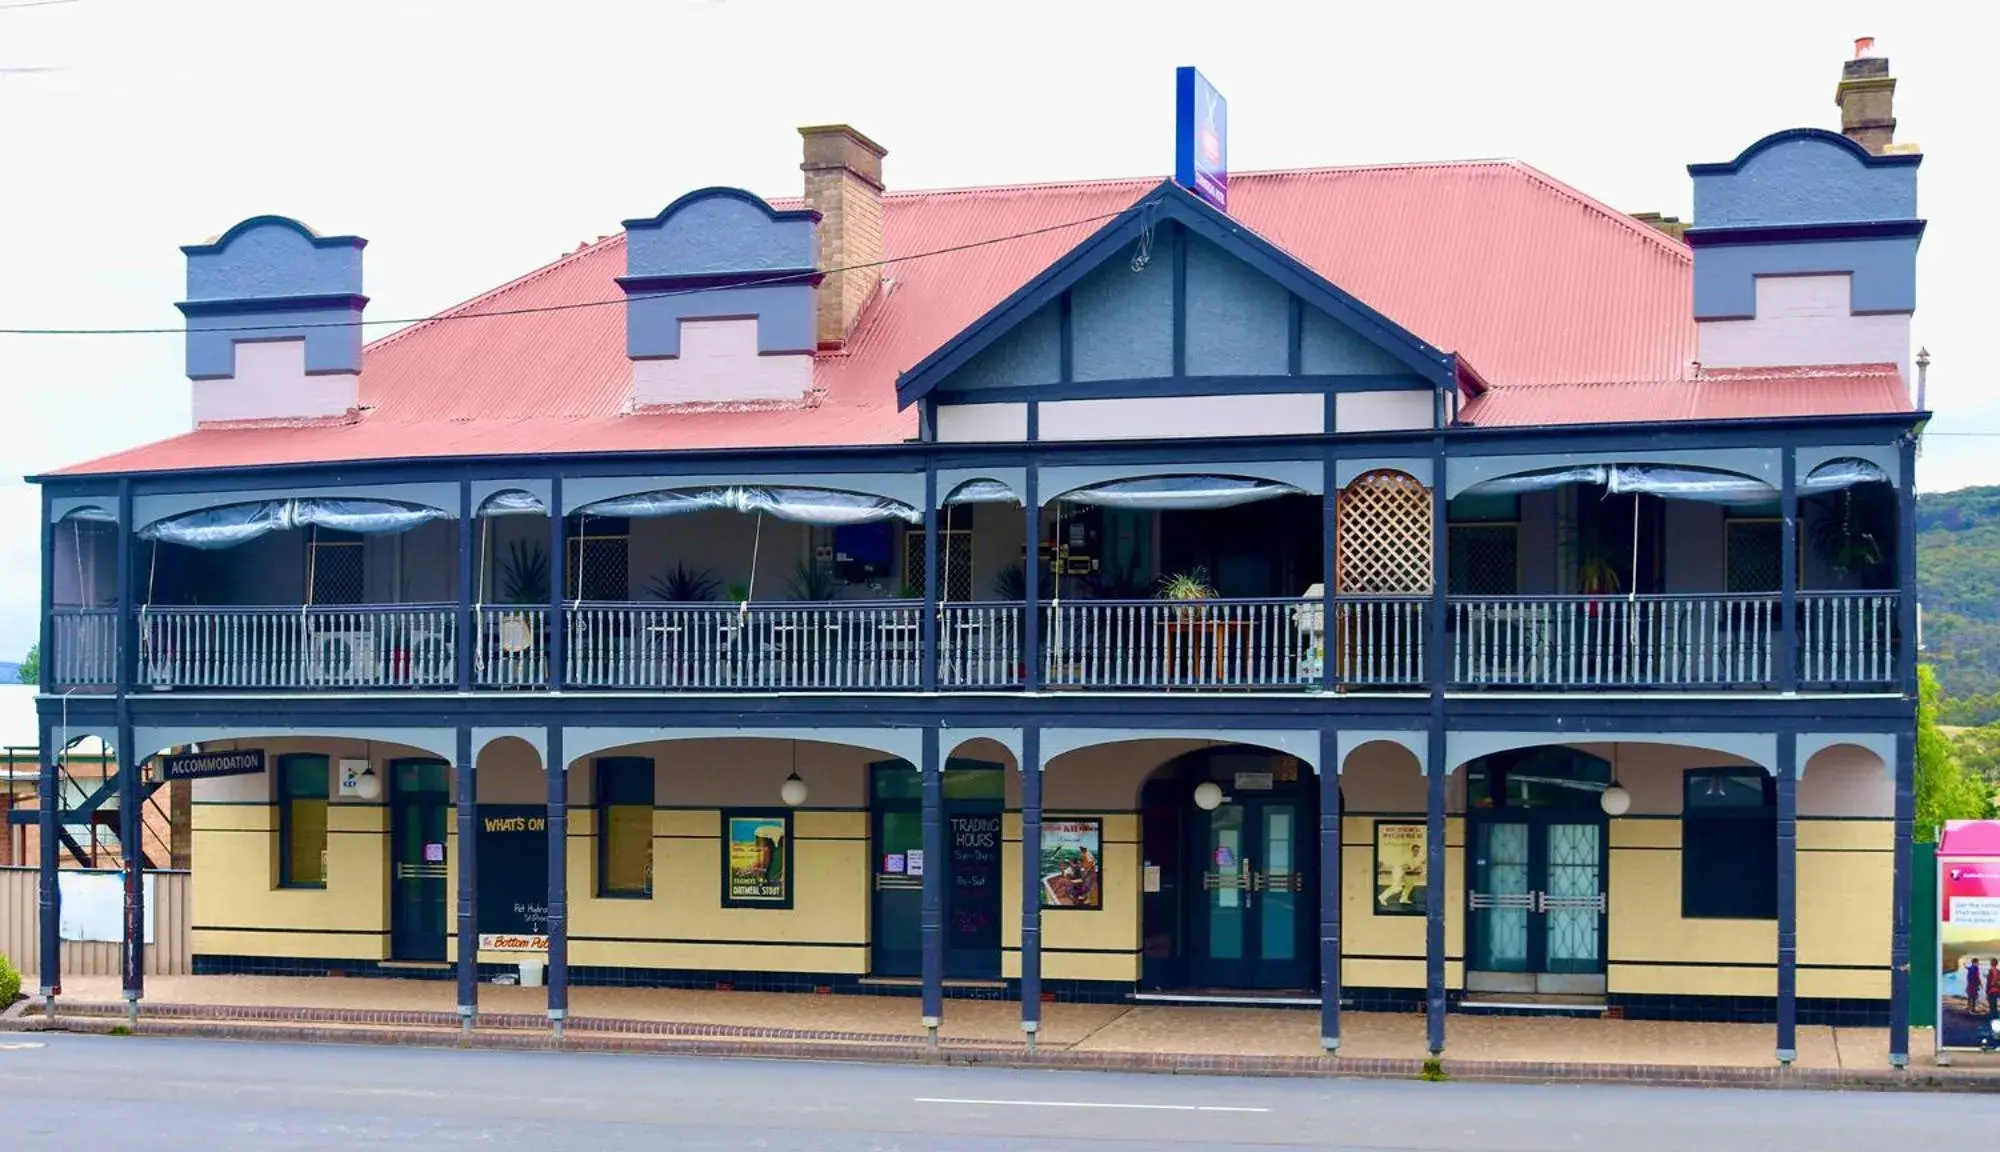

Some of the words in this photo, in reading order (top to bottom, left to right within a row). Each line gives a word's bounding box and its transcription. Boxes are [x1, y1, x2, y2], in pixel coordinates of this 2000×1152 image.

[171, 755, 258, 774] ACCOMMODATION
[528, 818, 545, 831] ON
[951, 818, 999, 832] TRADING
[956, 833, 994, 847] HOURS
[494, 935, 529, 948] Bottom
